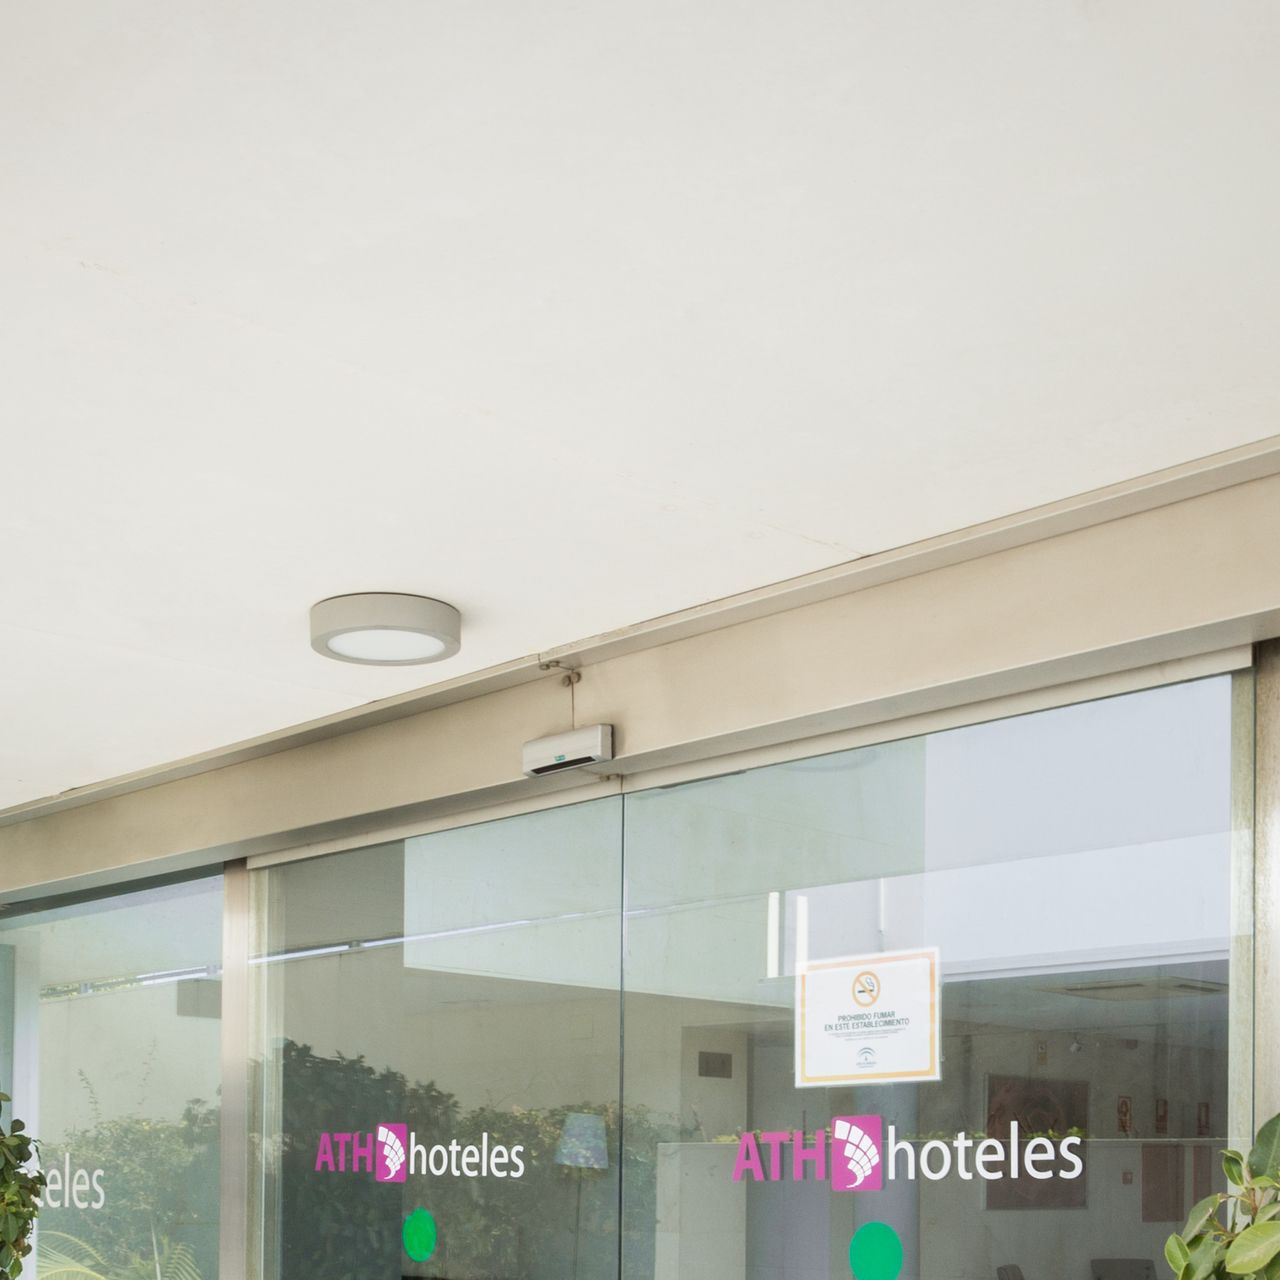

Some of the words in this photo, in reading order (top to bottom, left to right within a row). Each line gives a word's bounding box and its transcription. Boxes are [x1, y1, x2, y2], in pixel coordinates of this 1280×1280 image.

[824, 1024, 834, 1032] EN
[834, 1022, 850, 1031] ESTE
[851, 1018, 910, 1029] ESTABLECIMIENTO
[837, 1013, 872, 1021] PROHIBIDO
[873, 1010, 896, 1020] FUMAR
[315, 1132, 373, 1173] ATH
[409, 1131, 525, 1178] hoteles
[732, 1129, 827, 1182] ATH
[888, 1120, 1084, 1181] hoteles
